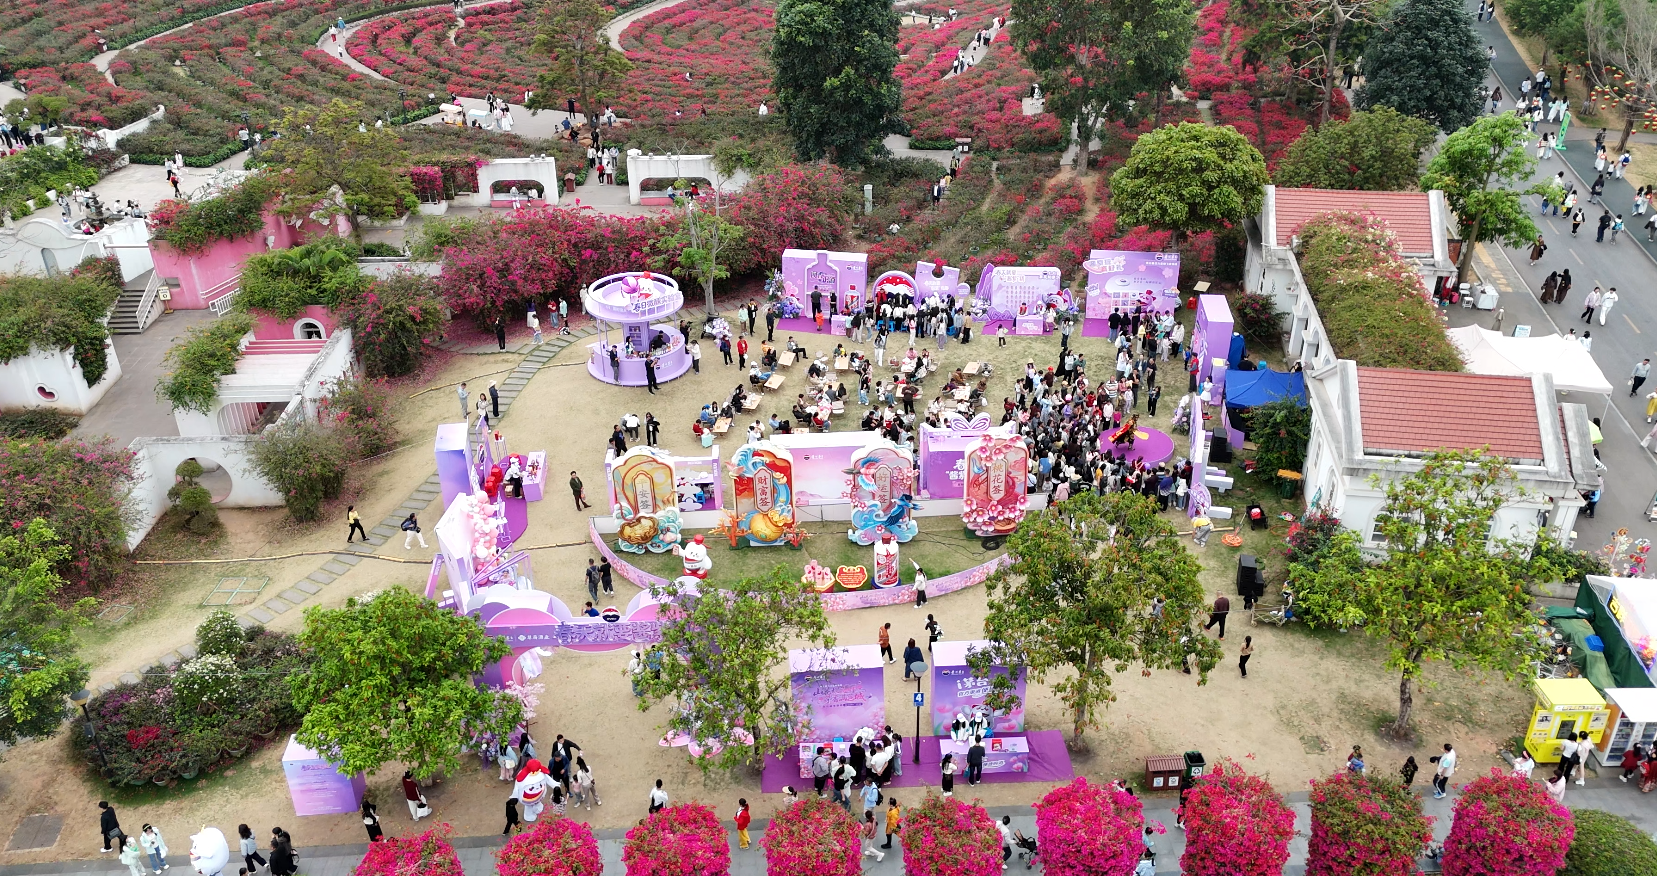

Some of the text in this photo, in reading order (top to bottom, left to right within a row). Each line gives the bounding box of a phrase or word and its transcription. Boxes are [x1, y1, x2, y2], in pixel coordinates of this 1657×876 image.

[636, 477, 652, 510] 平安签
[757, 475, 769, 507] 财富签
[876, 472, 889, 504] 好运签
[992, 462, 1003, 495] 桃花签
[916, 693, 922, 702] 4
[957, 677, 988, 689] i茅台
